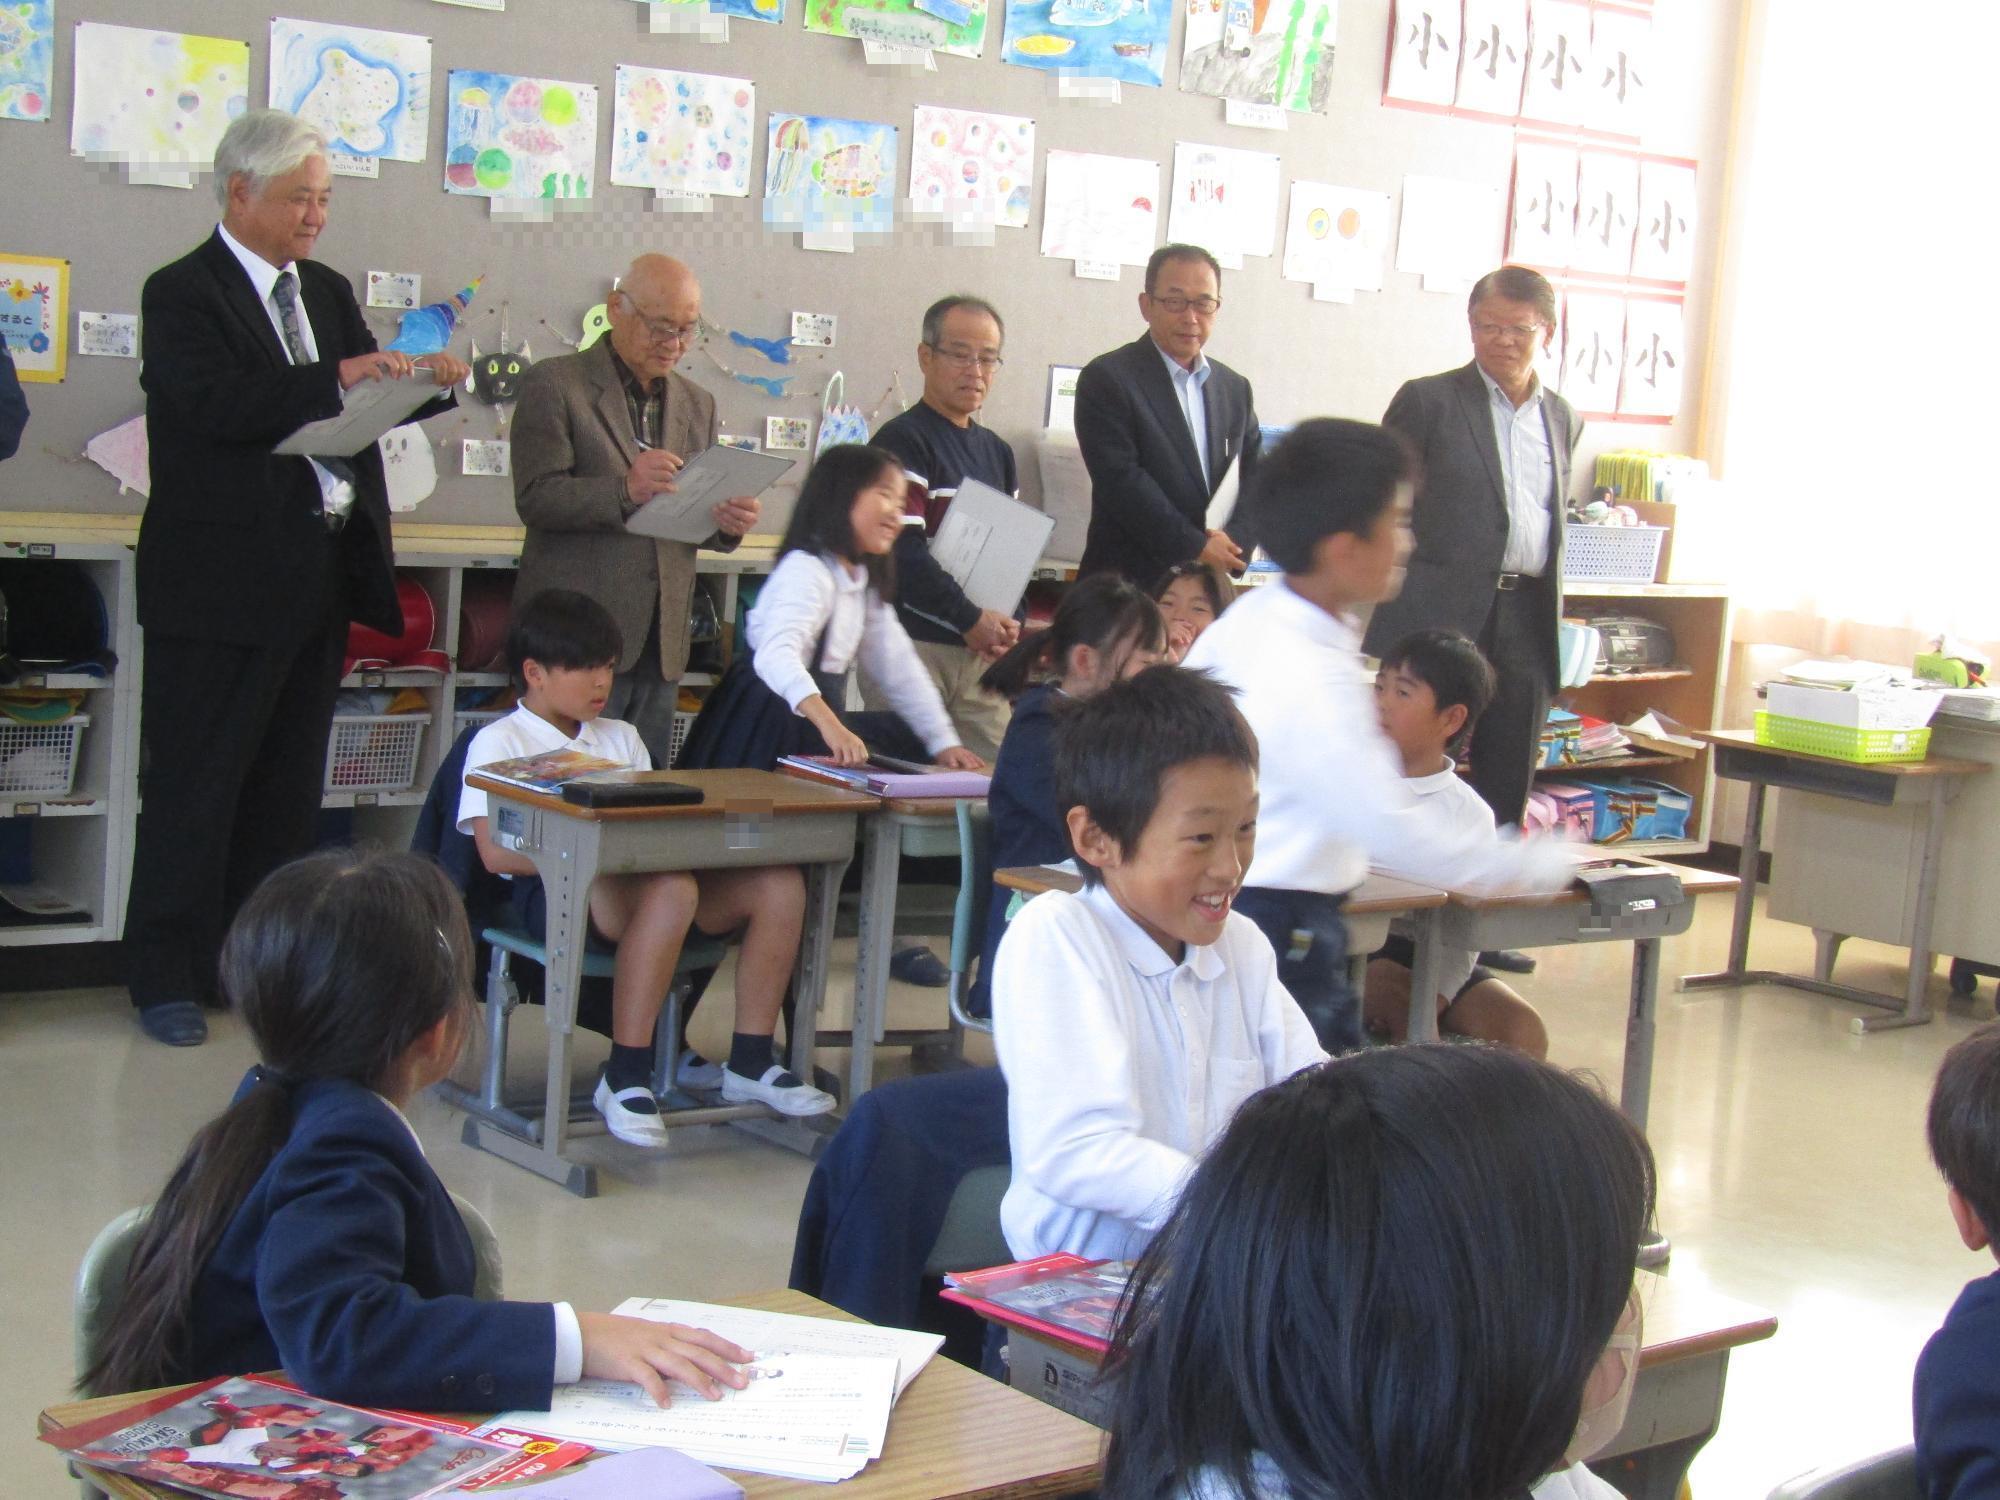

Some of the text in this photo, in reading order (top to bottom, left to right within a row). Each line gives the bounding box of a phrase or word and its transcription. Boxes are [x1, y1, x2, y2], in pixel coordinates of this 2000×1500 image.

[1409, 12, 1448, 70] 小
[1474, 24, 1516, 80] 小
[1541, 34, 1583, 90] 小
[1602, 51, 1643, 103] 小
[1528, 179, 1564, 235] 小
[1588, 191, 1626, 247] 小
[1650, 200, 1686, 254] 小
[1576, 331, 1612, 384] 小
[1636, 332, 1676, 388] 小
